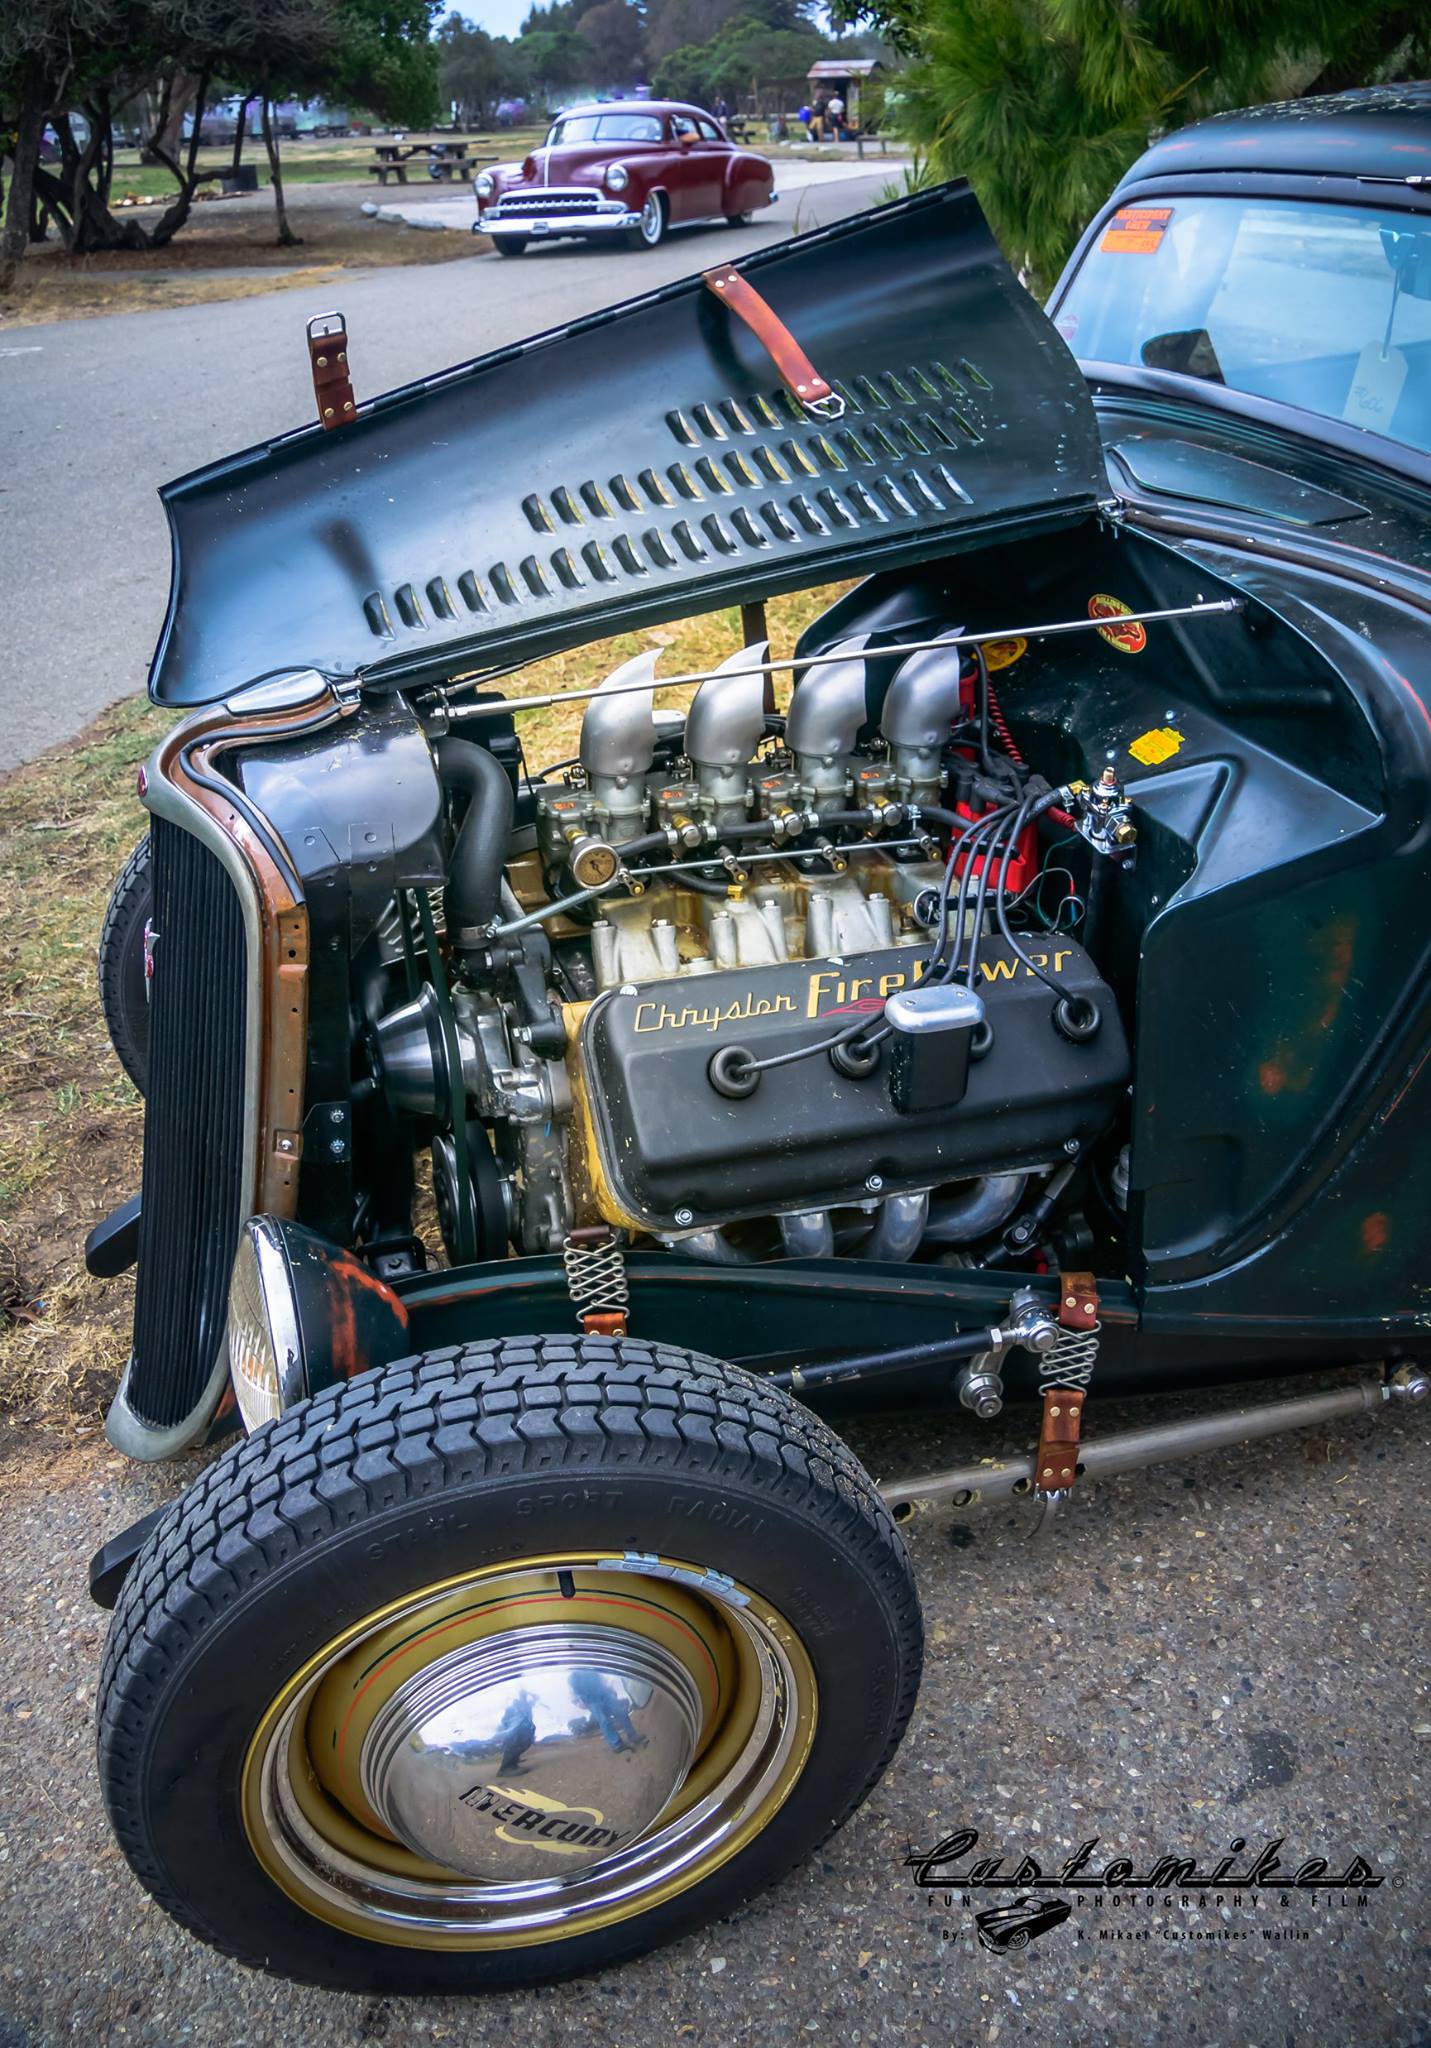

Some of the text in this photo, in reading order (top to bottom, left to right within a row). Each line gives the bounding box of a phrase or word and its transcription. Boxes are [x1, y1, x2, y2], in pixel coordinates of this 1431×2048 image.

[633, 949, 1074, 1033] Chrysler Firewer
[515, 1488, 624, 1518] SPORT
[458, 1785, 631, 1848] MERCURY
